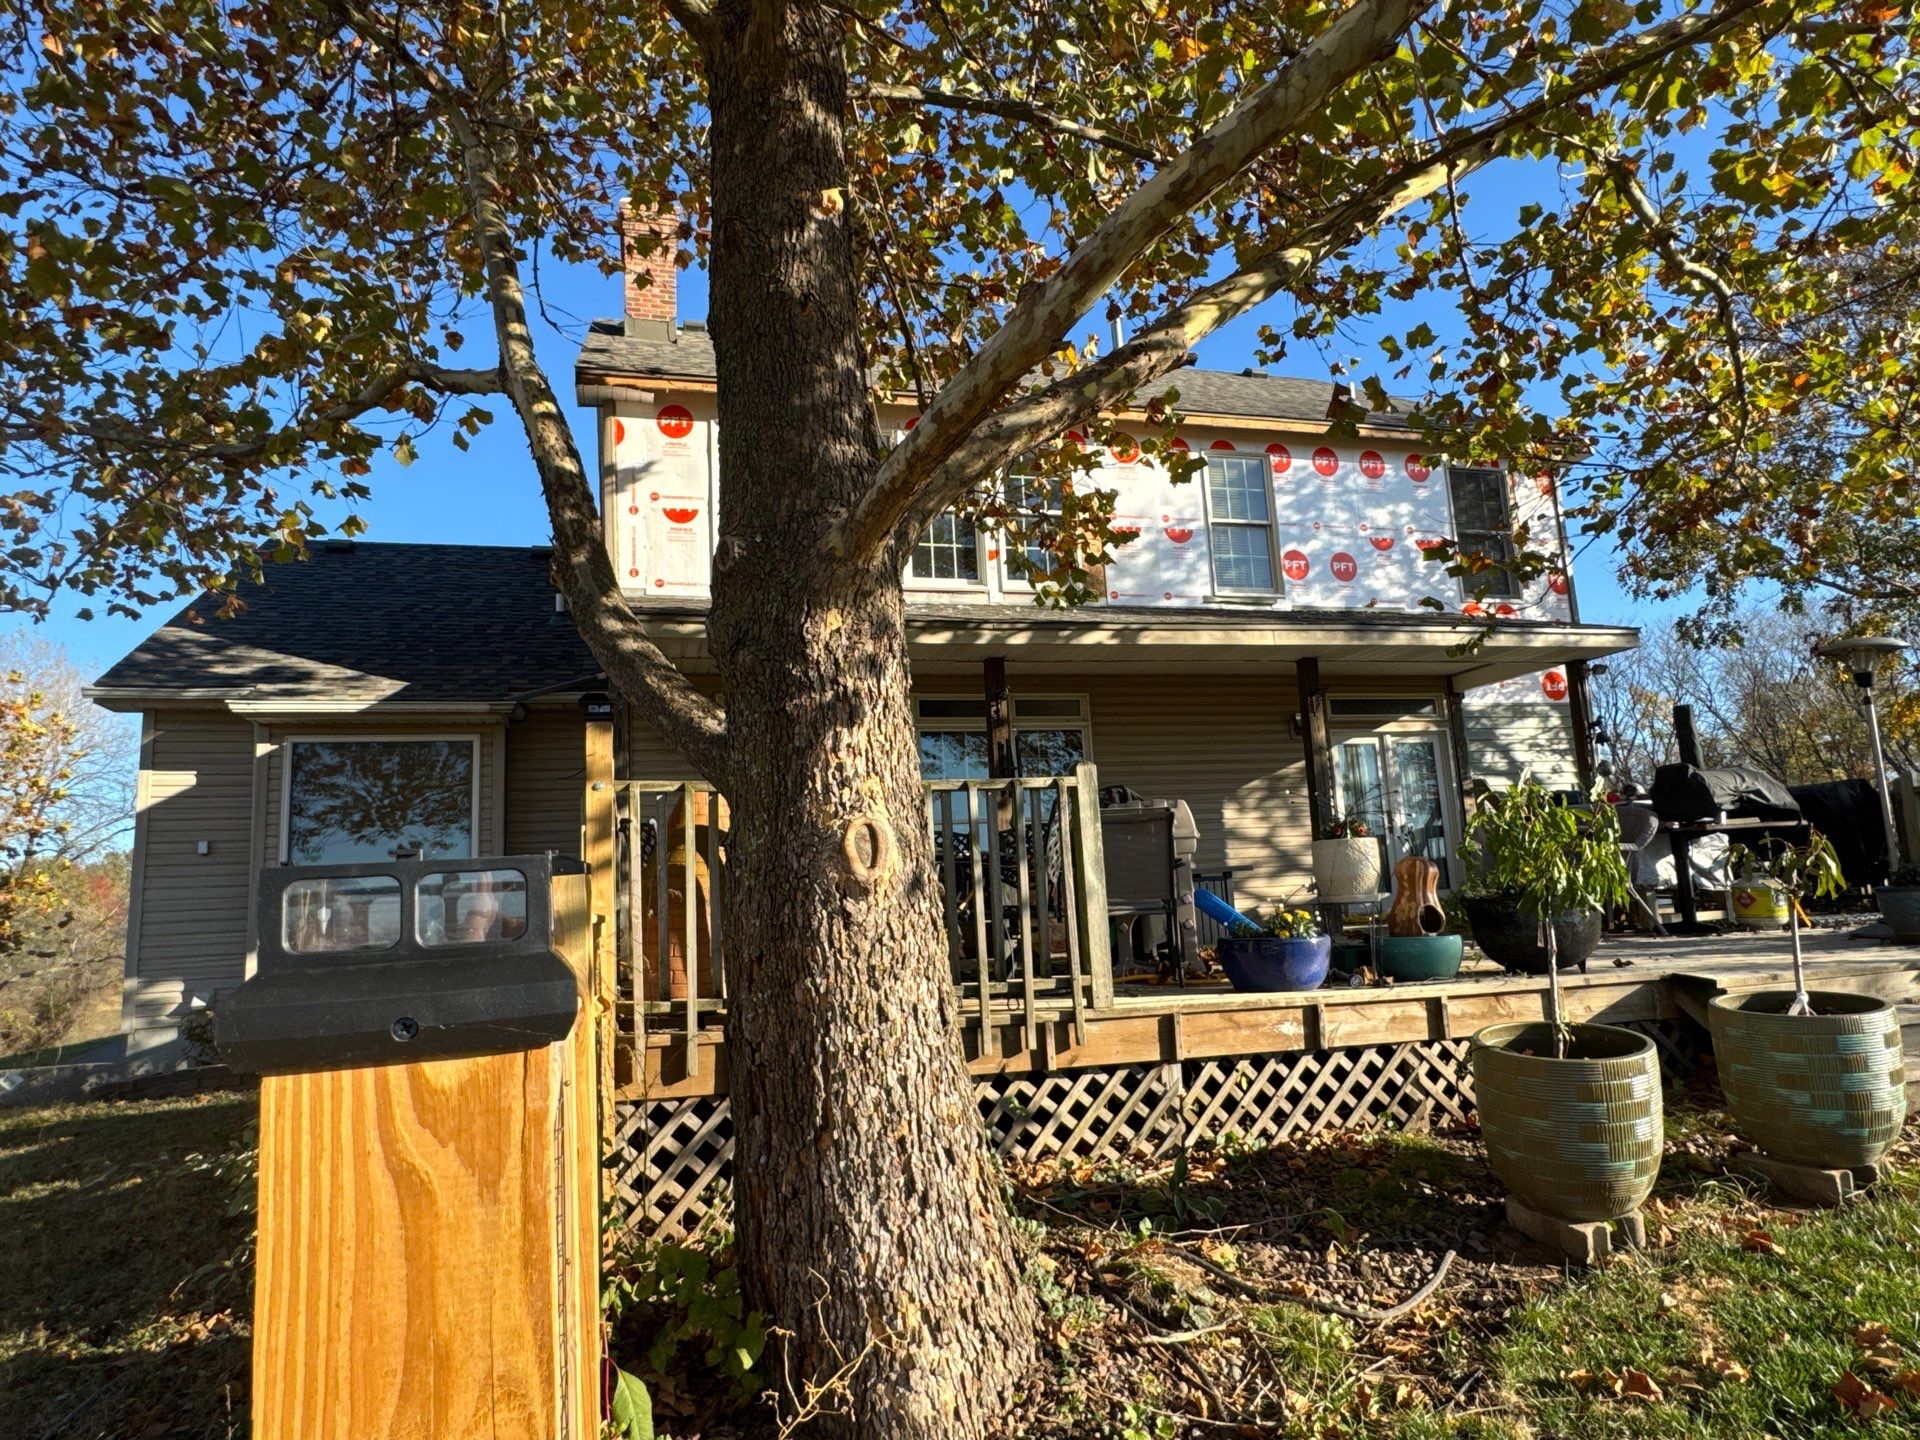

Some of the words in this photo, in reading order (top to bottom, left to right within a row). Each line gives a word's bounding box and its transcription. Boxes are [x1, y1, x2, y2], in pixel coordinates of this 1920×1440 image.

[1315, 456, 1337, 466] PFT
[1362, 460, 1383, 470] PFT
[1285, 560, 1306, 571] PFT
[1334, 562, 1354, 572] PFT
